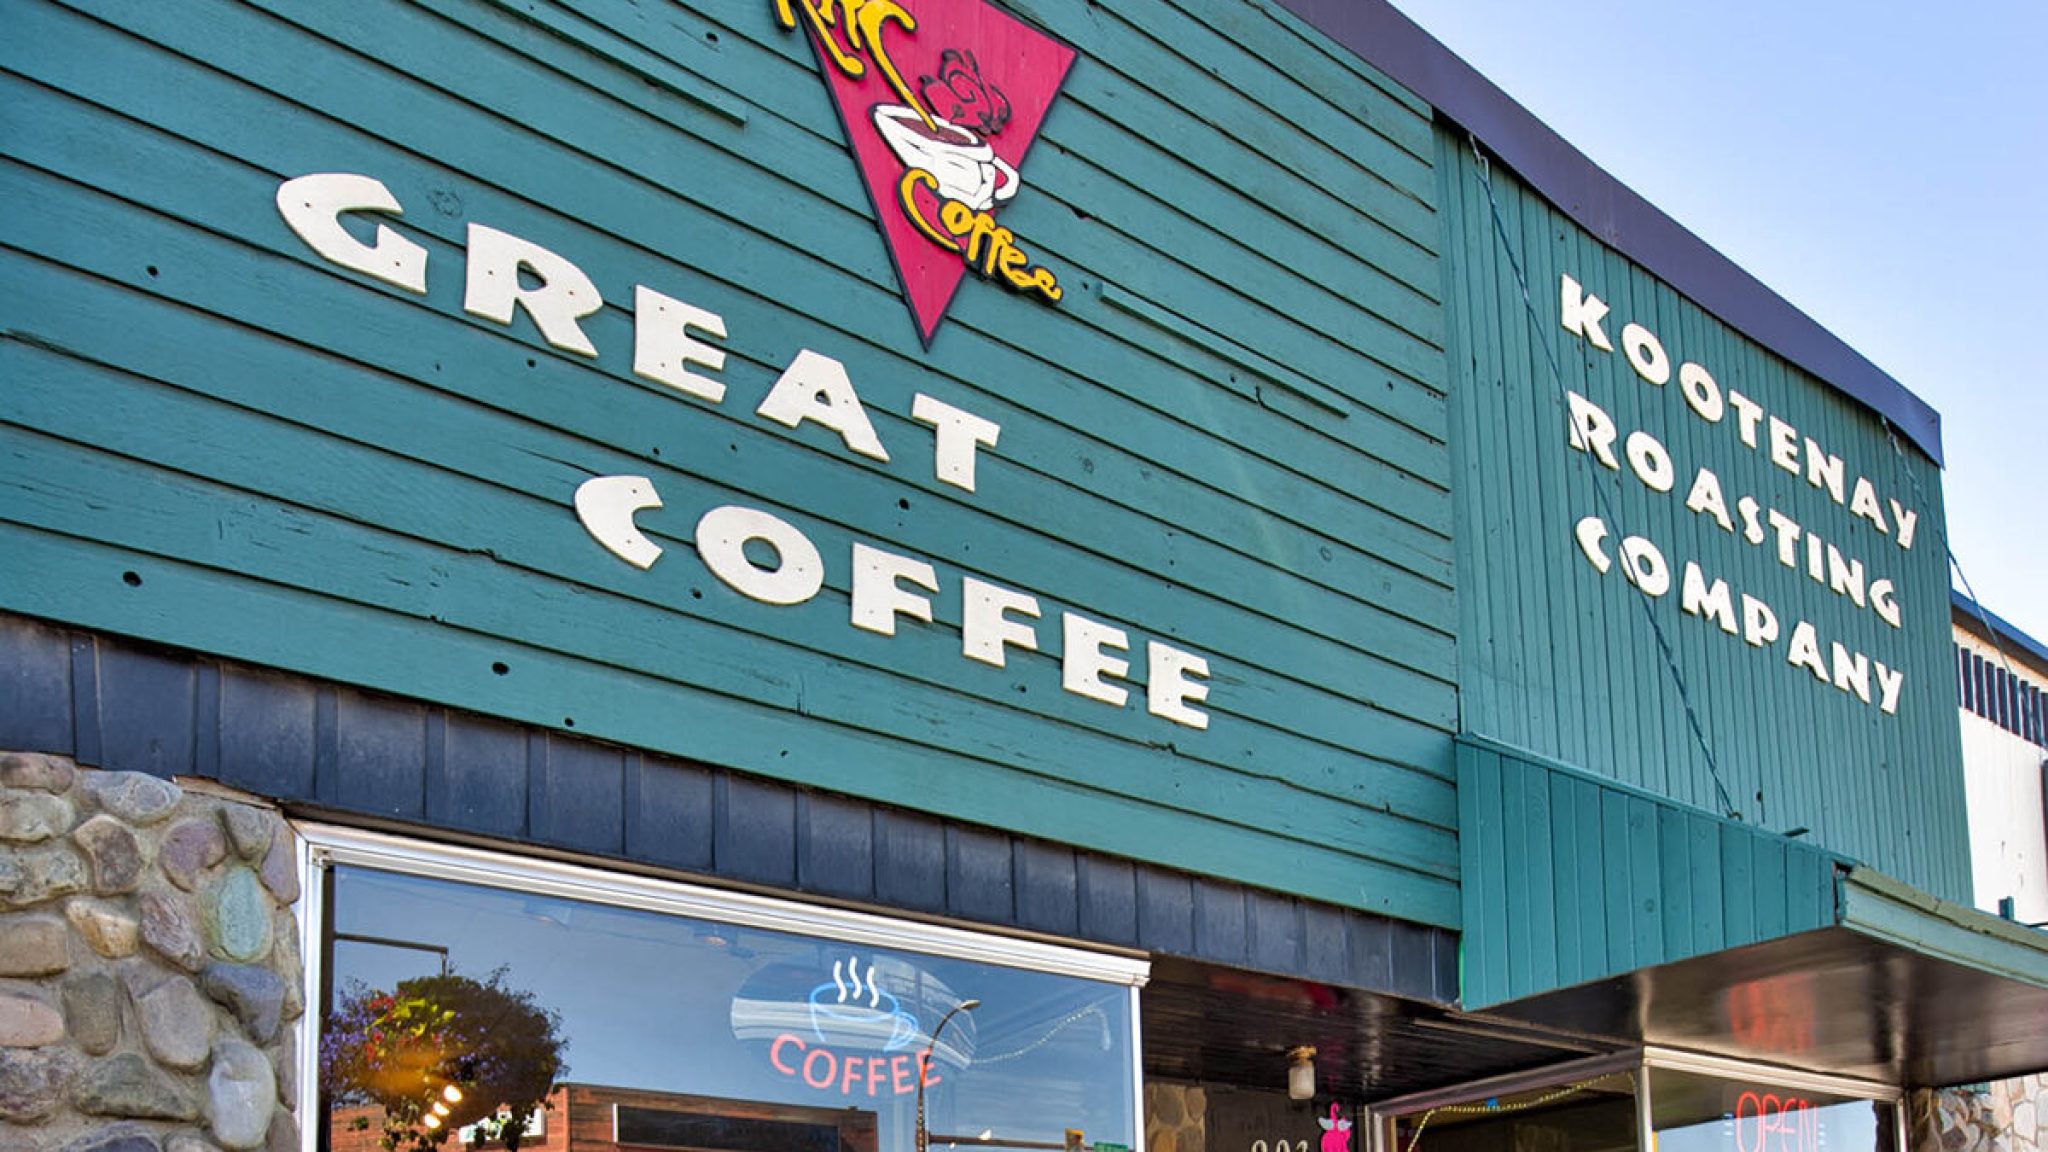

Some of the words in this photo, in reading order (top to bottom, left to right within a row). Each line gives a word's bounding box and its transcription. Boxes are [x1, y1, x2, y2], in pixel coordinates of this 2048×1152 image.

[276, 173, 1001, 492] GREAT
[900, 168, 1063, 303] Coffee
[1561, 273, 1917, 549] KOOTENAY
[1567, 390, 1901, 628] ROASTING
[574, 475, 1211, 729] COFFEE
[1575, 516, 1904, 715] COMPANY
[769, 1033, 942, 1097] COFFEE
[1735, 1090, 1819, 1152] OPEN
